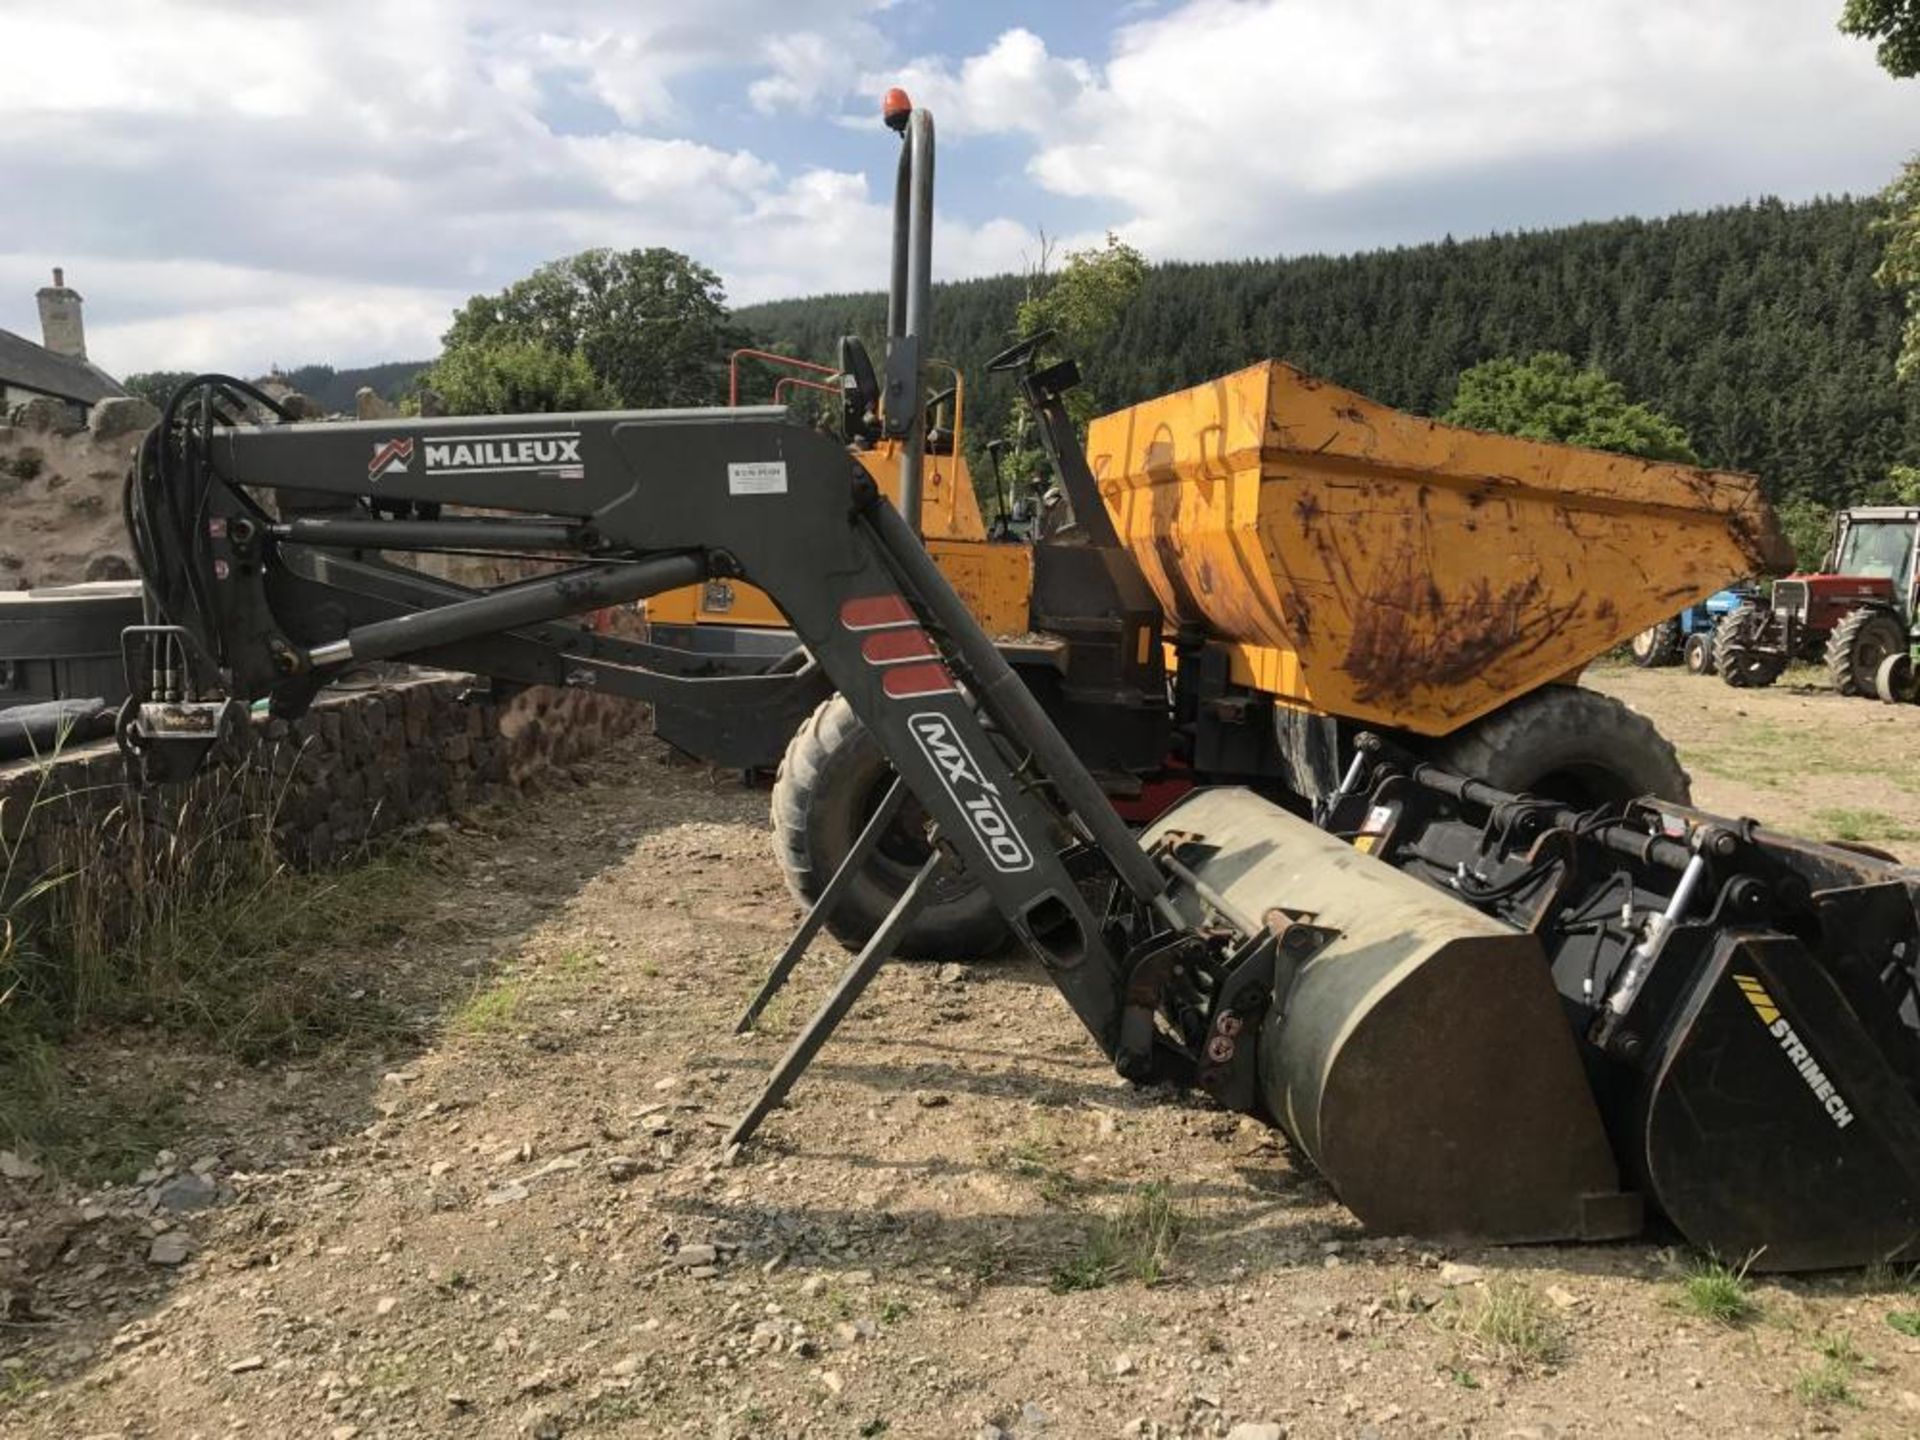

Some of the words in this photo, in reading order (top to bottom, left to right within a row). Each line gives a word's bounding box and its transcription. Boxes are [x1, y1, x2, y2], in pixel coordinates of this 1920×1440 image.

[424, 440, 582, 467] MAILLEUX
[918, 723, 980, 784] MX
[965, 793, 1023, 863] 100
[1769, 1018, 1854, 1128] STRIMECH
